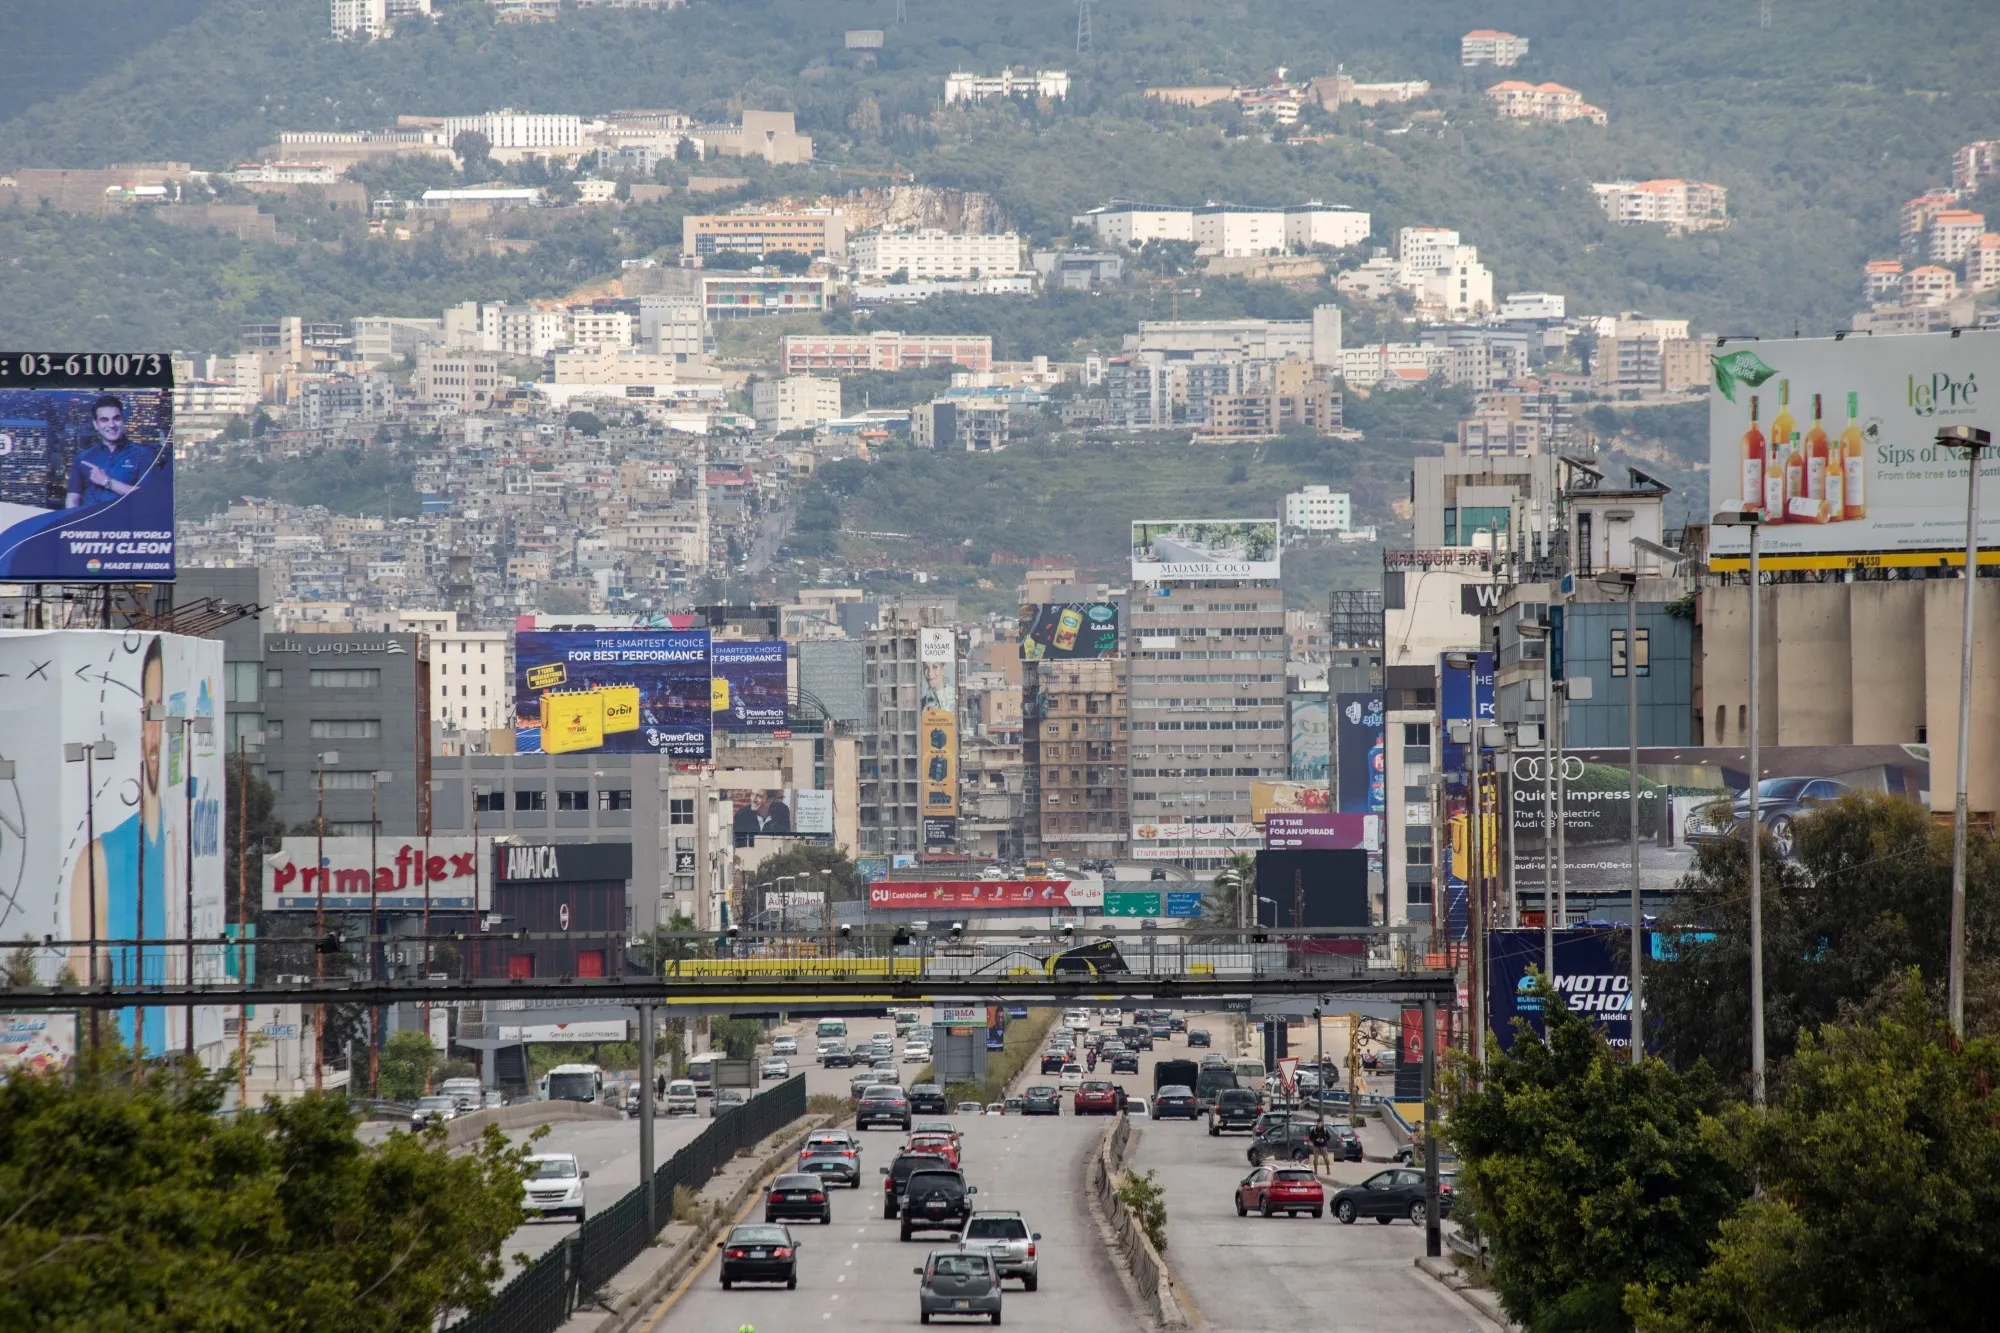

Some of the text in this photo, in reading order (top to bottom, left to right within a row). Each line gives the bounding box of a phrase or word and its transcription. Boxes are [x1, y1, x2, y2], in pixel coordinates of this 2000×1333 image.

[20, 353, 162, 376] 03-610073
[1735, 355, 1757, 371] 100%
[1733, 366, 1757, 380] PURE
[1877, 444, 1915, 467] Sips
[1921, 443, 1939, 463] of
[1877, 470, 1905, 480] From
[1907, 470, 1921, 480] the
[1924, 470, 1944, 479] tree
[1947, 468, 1957, 478] to
[60, 531, 171, 539] POWER YOUR WORLD
[70, 542, 172, 554] WITH CLEON
[103, 562, 170, 570] MADE IN INDIA
[1160, 563, 1250, 573] MADAME COCO
[269, 638, 385, 655] سيدروس بنك
[595, 639, 704, 648] THE SMARTEST CHOICE
[568, 650, 704, 661] FOR BEST PERFORMANCE
[607, 704, 632, 716] Orbit
[746, 709, 783, 717] PowerTech
[660, 733, 704, 742] PowerTech
[1567, 789, 1658, 802] impressve.
[1515, 810, 1533, 818] The
[1563, 810, 1600, 818] electric
[1514, 820, 1538, 828] Audi
[1299, 828, 1334, 836] UPGRADE
[273, 844, 476, 893] Primaflex
[872, 889, 927, 902] CU CashUnited
[695, 967, 717, 976] You
[812, 965, 829, 976] for
[1553, 975, 1640, 991] MOTO
[954, 1009, 976, 1018] BMA
[1600, 1013, 1627, 1021] Middle
